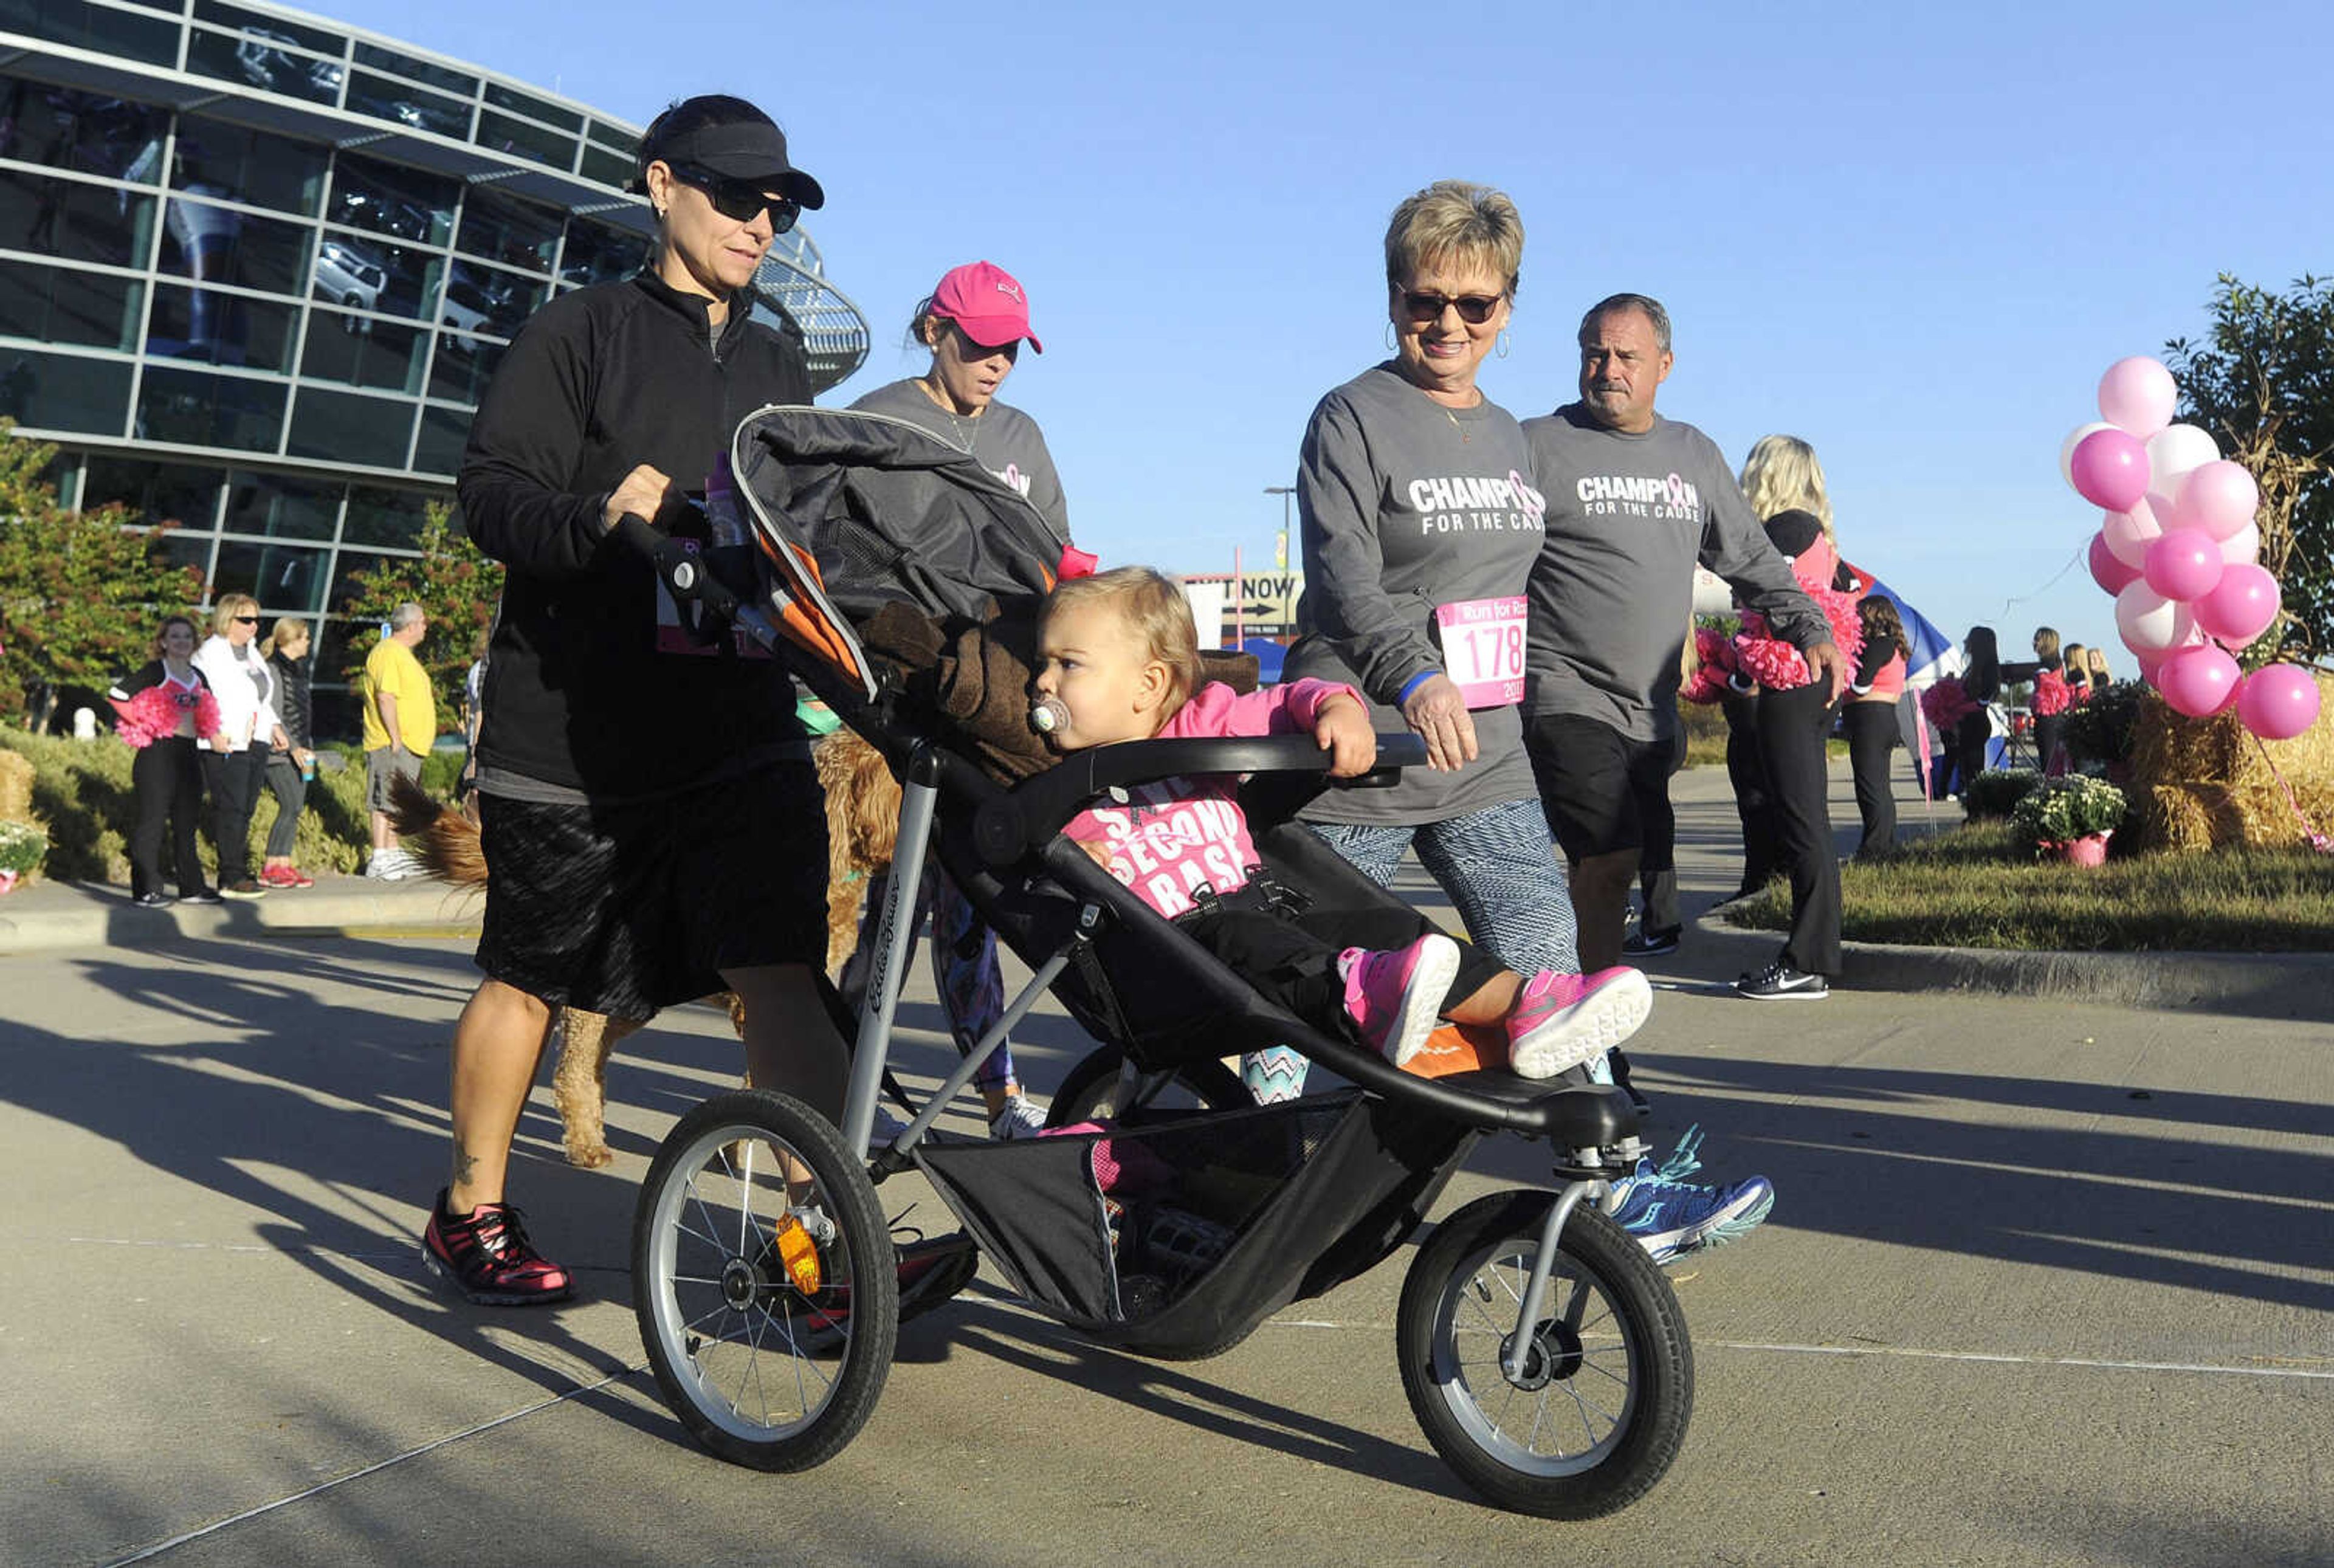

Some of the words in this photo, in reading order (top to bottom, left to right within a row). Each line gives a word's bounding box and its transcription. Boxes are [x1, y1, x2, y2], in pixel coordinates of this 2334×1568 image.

[1585, 501, 1617, 516] FOR
[1622, 502, 1648, 517] THE
[1654, 504, 1699, 523] CAUSE
[1422, 513, 1464, 535] FOR
[1470, 513, 1504, 531] THE
[1509, 512, 1546, 532] CAU
[1241, 578, 1295, 599] NOW
[1462, 603, 1493, 620] Run
[1464, 624, 1522, 679] 178
[1108, 800, 1238, 887] SECOND
